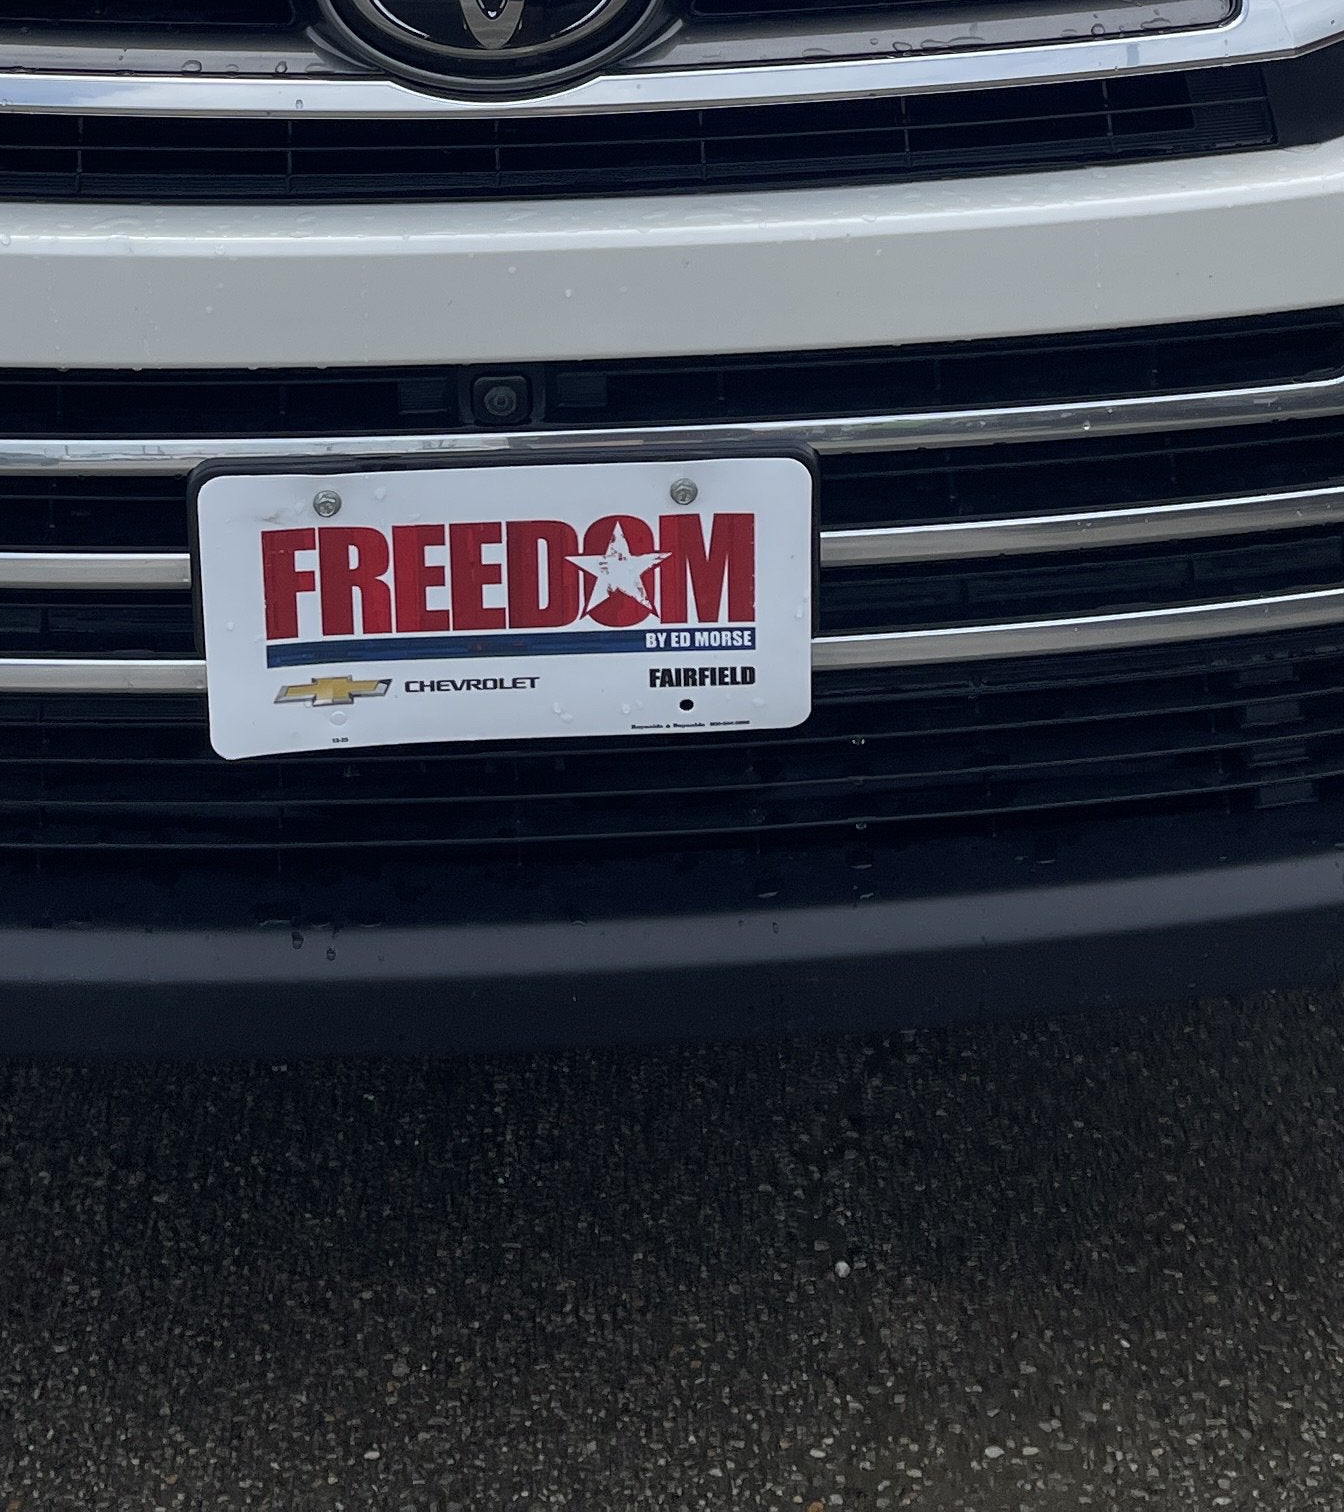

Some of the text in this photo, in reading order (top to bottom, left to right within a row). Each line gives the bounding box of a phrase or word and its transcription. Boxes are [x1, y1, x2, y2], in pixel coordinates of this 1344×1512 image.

[261, 512, 756, 640] FREEDOM
[645, 630, 752, 648] BY ED MORSE
[405, 676, 540, 693] CHEVROLET
[649, 666, 756, 688] FAIRFIELD
